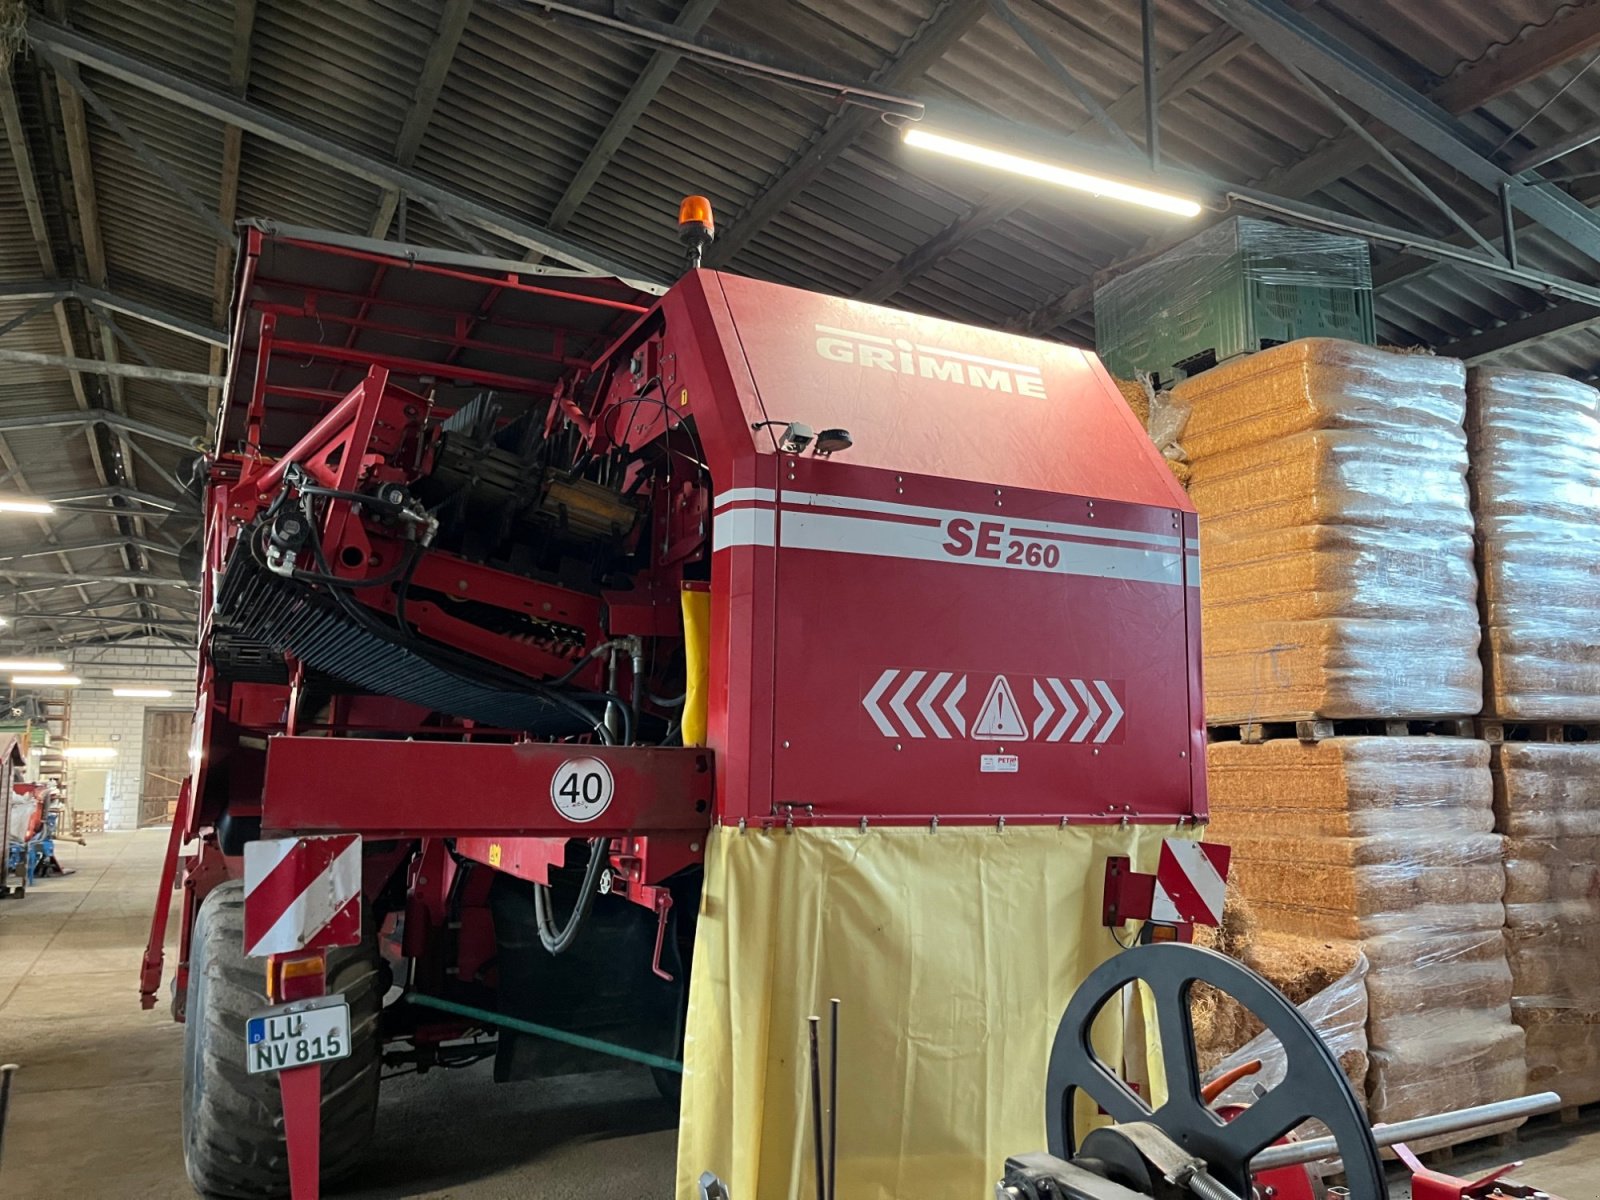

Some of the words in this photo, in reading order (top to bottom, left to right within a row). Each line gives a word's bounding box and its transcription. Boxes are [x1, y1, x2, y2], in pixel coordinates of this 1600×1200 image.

[942, 518, 1005, 560] SE
[1006, 540, 1060, 568] 260
[559, 772, 603, 804] 40
[270, 1015, 303, 1041] LU
[256, 1042, 289, 1070] NV
[296, 1034, 341, 1062] 815
